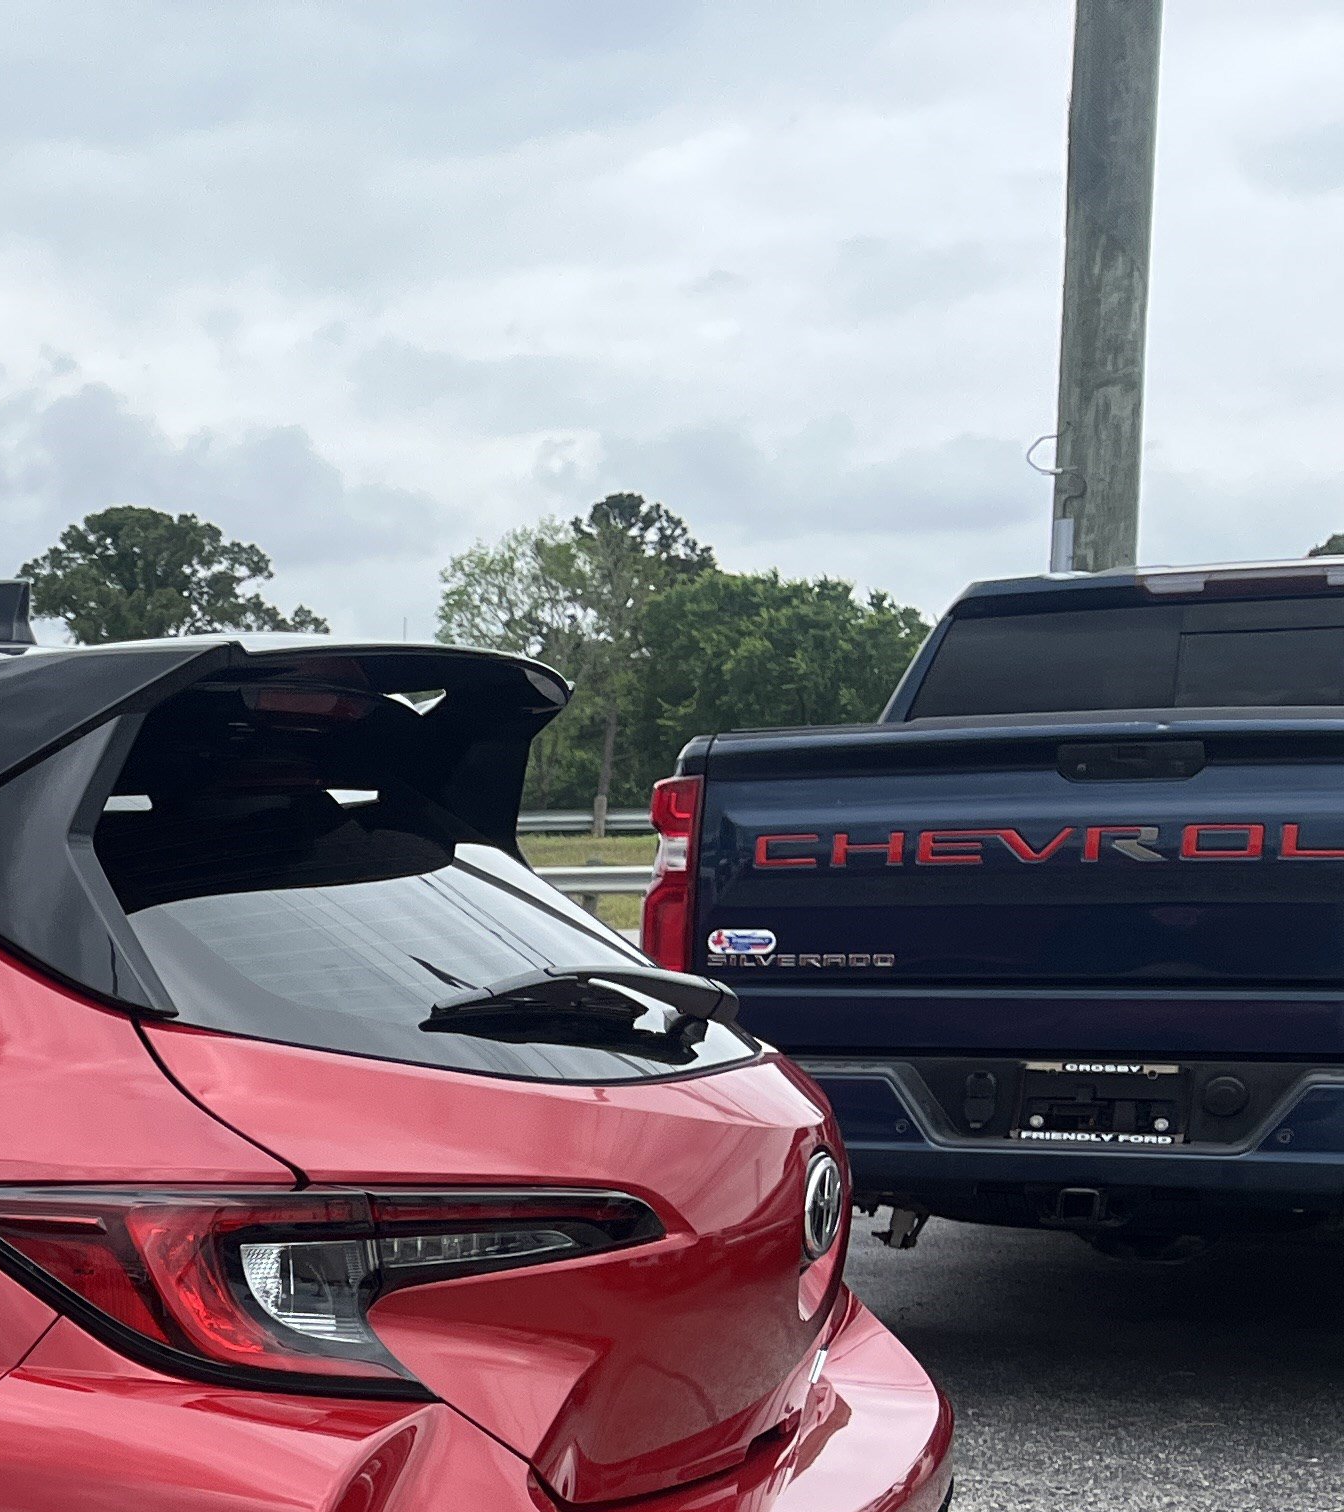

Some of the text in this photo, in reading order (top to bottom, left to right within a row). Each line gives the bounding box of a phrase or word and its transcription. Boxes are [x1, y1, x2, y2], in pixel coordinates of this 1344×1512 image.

[707, 954, 895, 968] SILVERADO
[1064, 1062, 1142, 1074] CROSBY
[1020, 1130, 1173, 1145] FRIENDLY FORD
